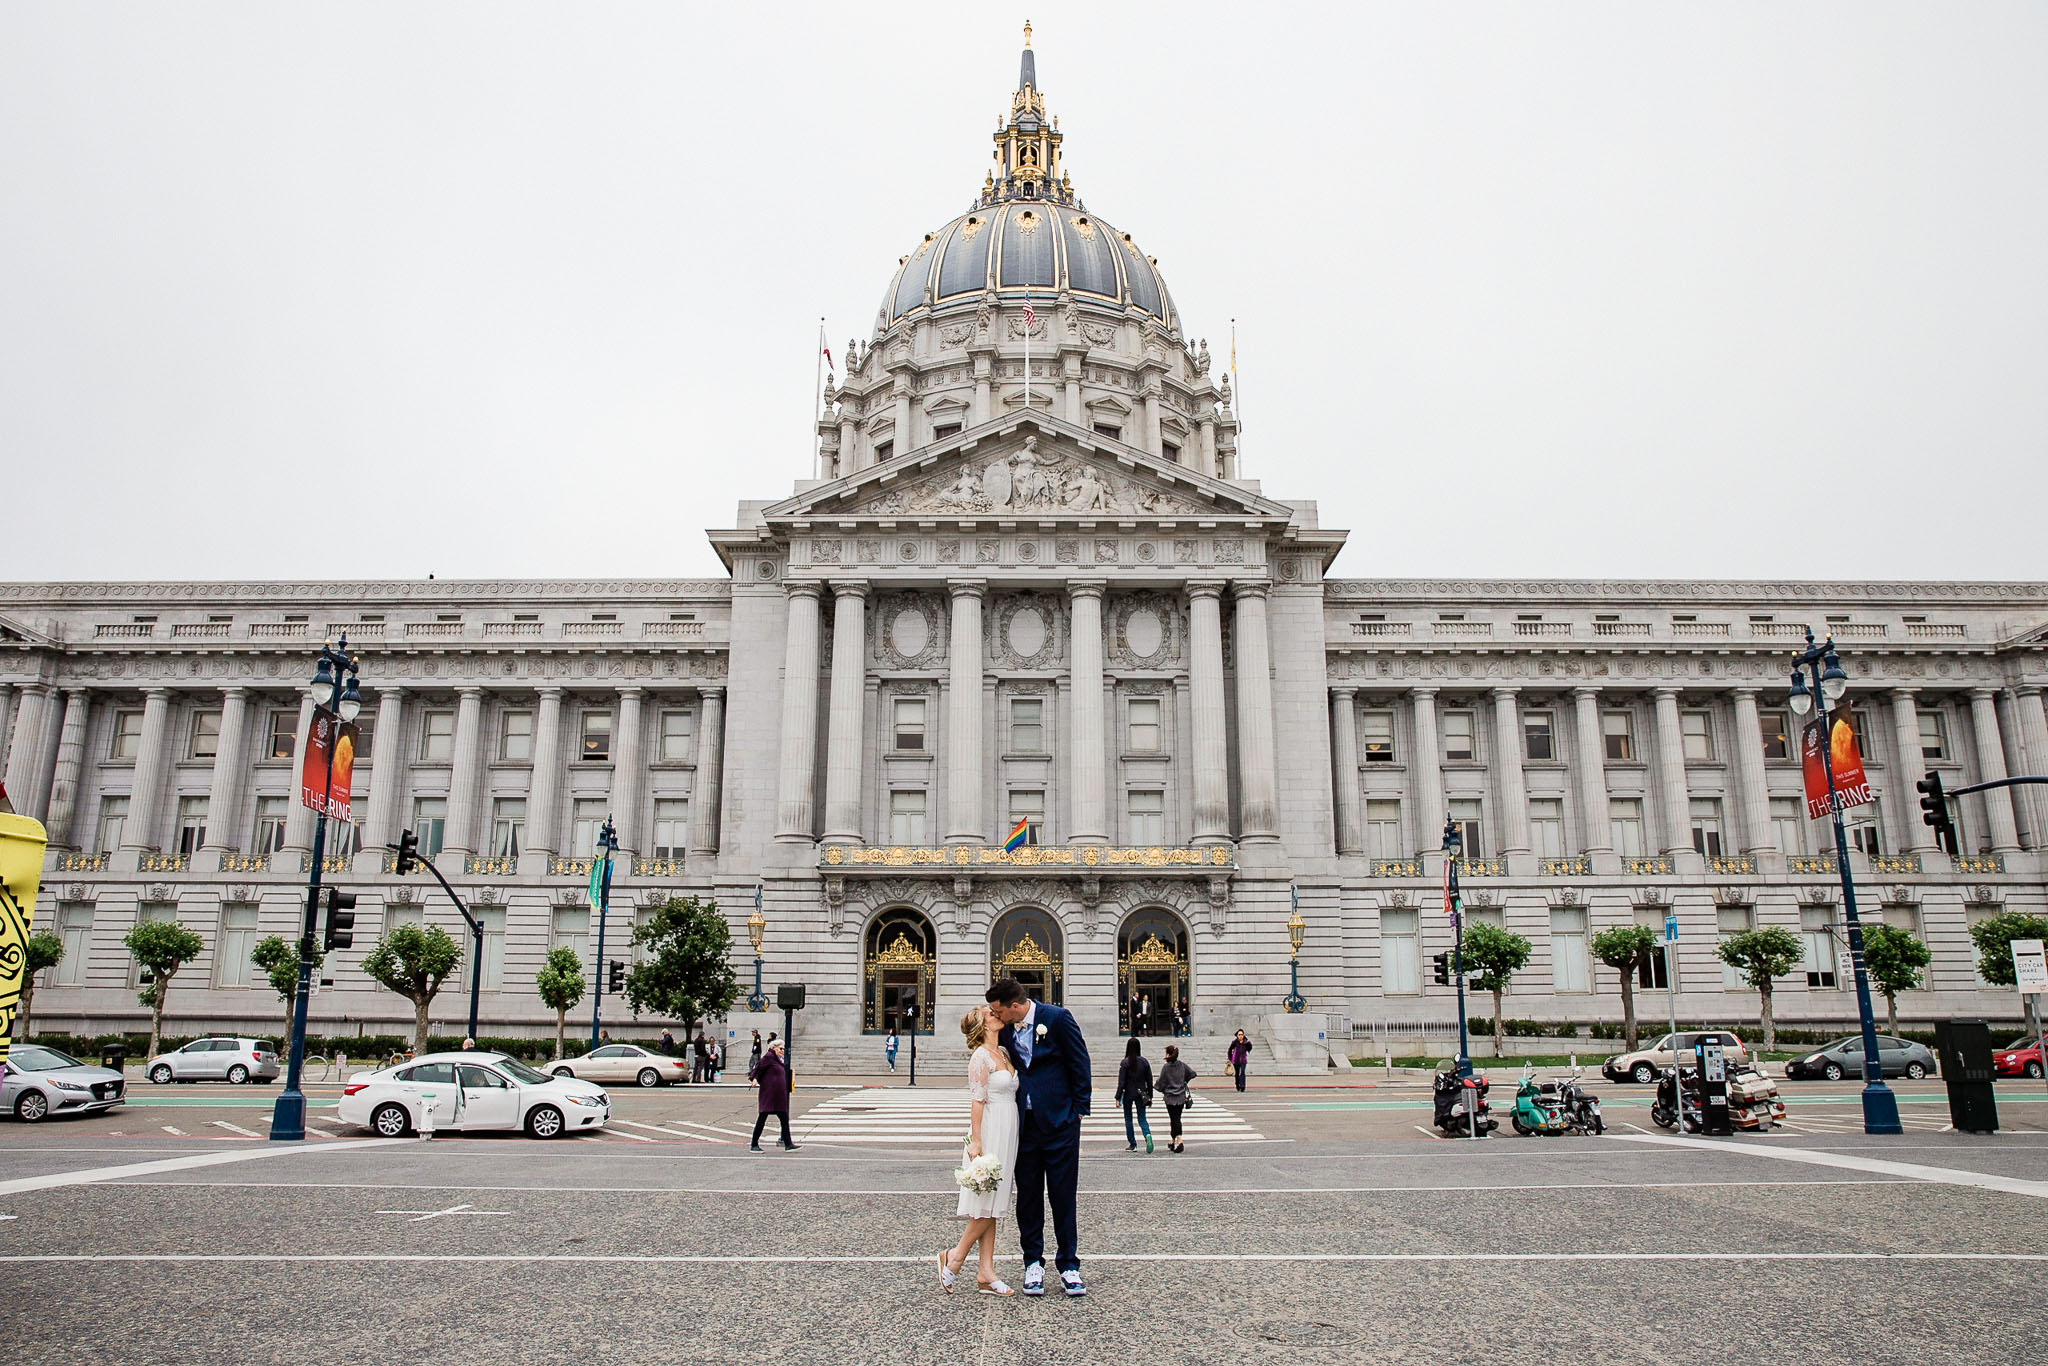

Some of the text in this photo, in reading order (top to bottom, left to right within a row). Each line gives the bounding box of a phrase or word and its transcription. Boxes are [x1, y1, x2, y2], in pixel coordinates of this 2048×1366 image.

[303, 786, 351, 823] THE RING
[1808, 782, 1874, 818] THE RING
